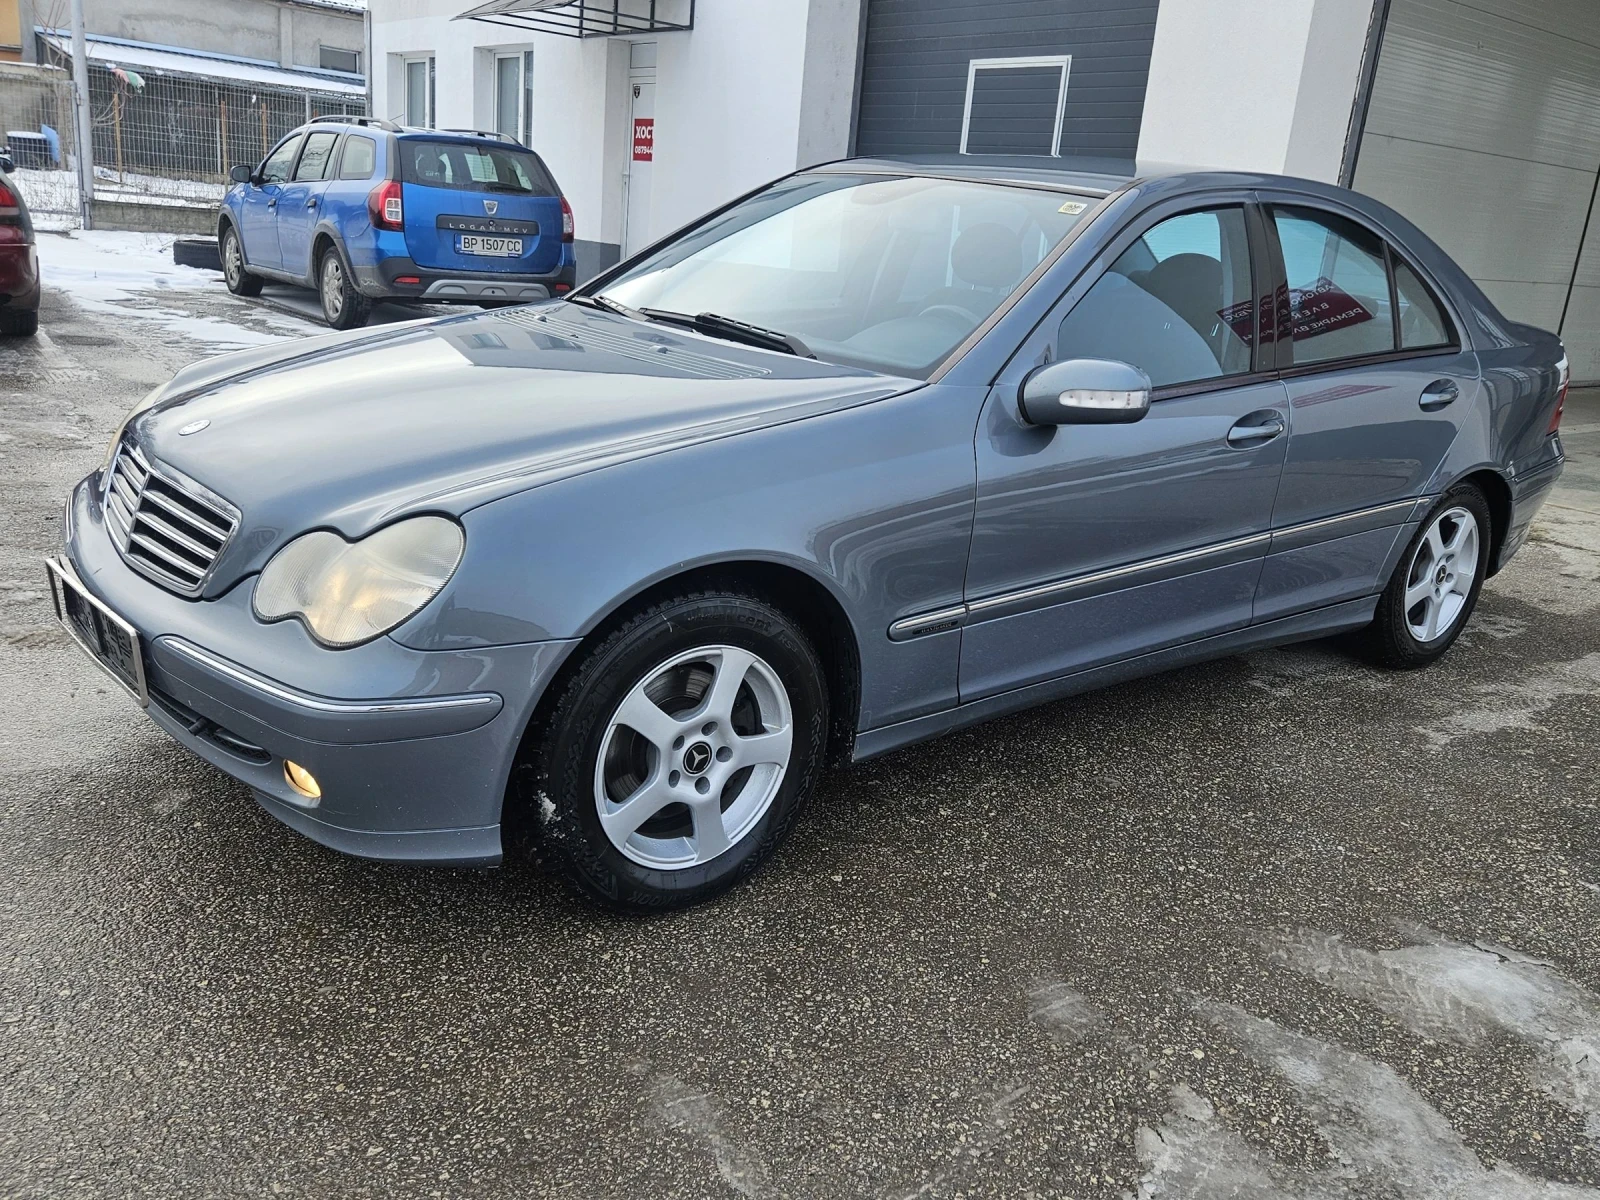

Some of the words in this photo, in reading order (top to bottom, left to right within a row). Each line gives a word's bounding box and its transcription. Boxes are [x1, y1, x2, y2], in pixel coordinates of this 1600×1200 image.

[449, 222, 496, 231] LOGAN
[463, 237, 478, 249] BP
[480, 238, 505, 251] 1507
